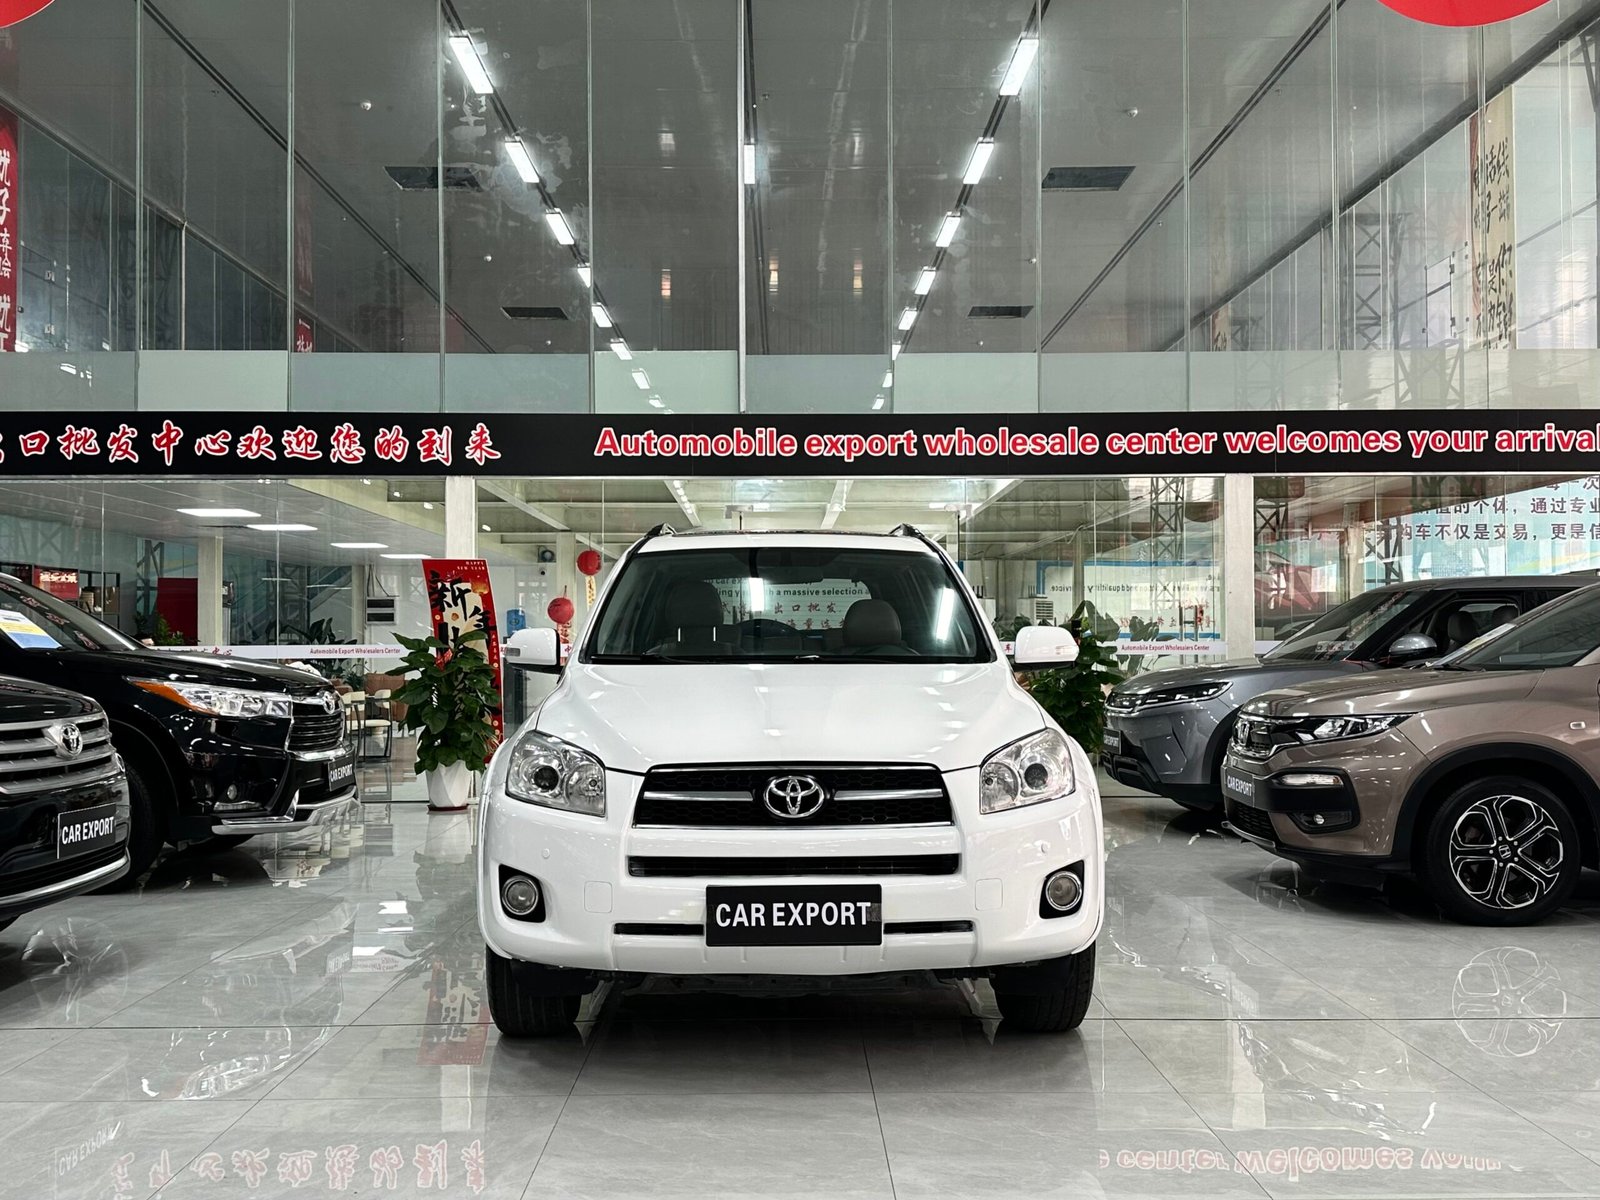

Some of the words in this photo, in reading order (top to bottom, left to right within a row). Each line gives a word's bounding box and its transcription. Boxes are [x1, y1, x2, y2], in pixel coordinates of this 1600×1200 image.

[0, 420, 501, 466] 口批发中心欢迎您的到来
[594, 427, 798, 456] Automobile
[804, 429, 917, 462] export
[923, 426, 1099, 456] wholesale
[1105, 428, 1217, 455] center
[1224, 424, 1401, 454] welcomes
[1408, 429, 1488, 458] your
[783, 588, 820, 596] massive
[822, 587, 863, 596] selection
[338, 647, 355, 655] Export
[337, 763, 353, 780] EXPORT
[1227, 775, 1236, 790] CAR
[1235, 778, 1252, 797] EXPORT
[62, 823, 81, 845] CAR
[82, 816, 115, 841] EXPORT
[715, 903, 766, 927] CAR
[772, 901, 872, 926] EXPORT
